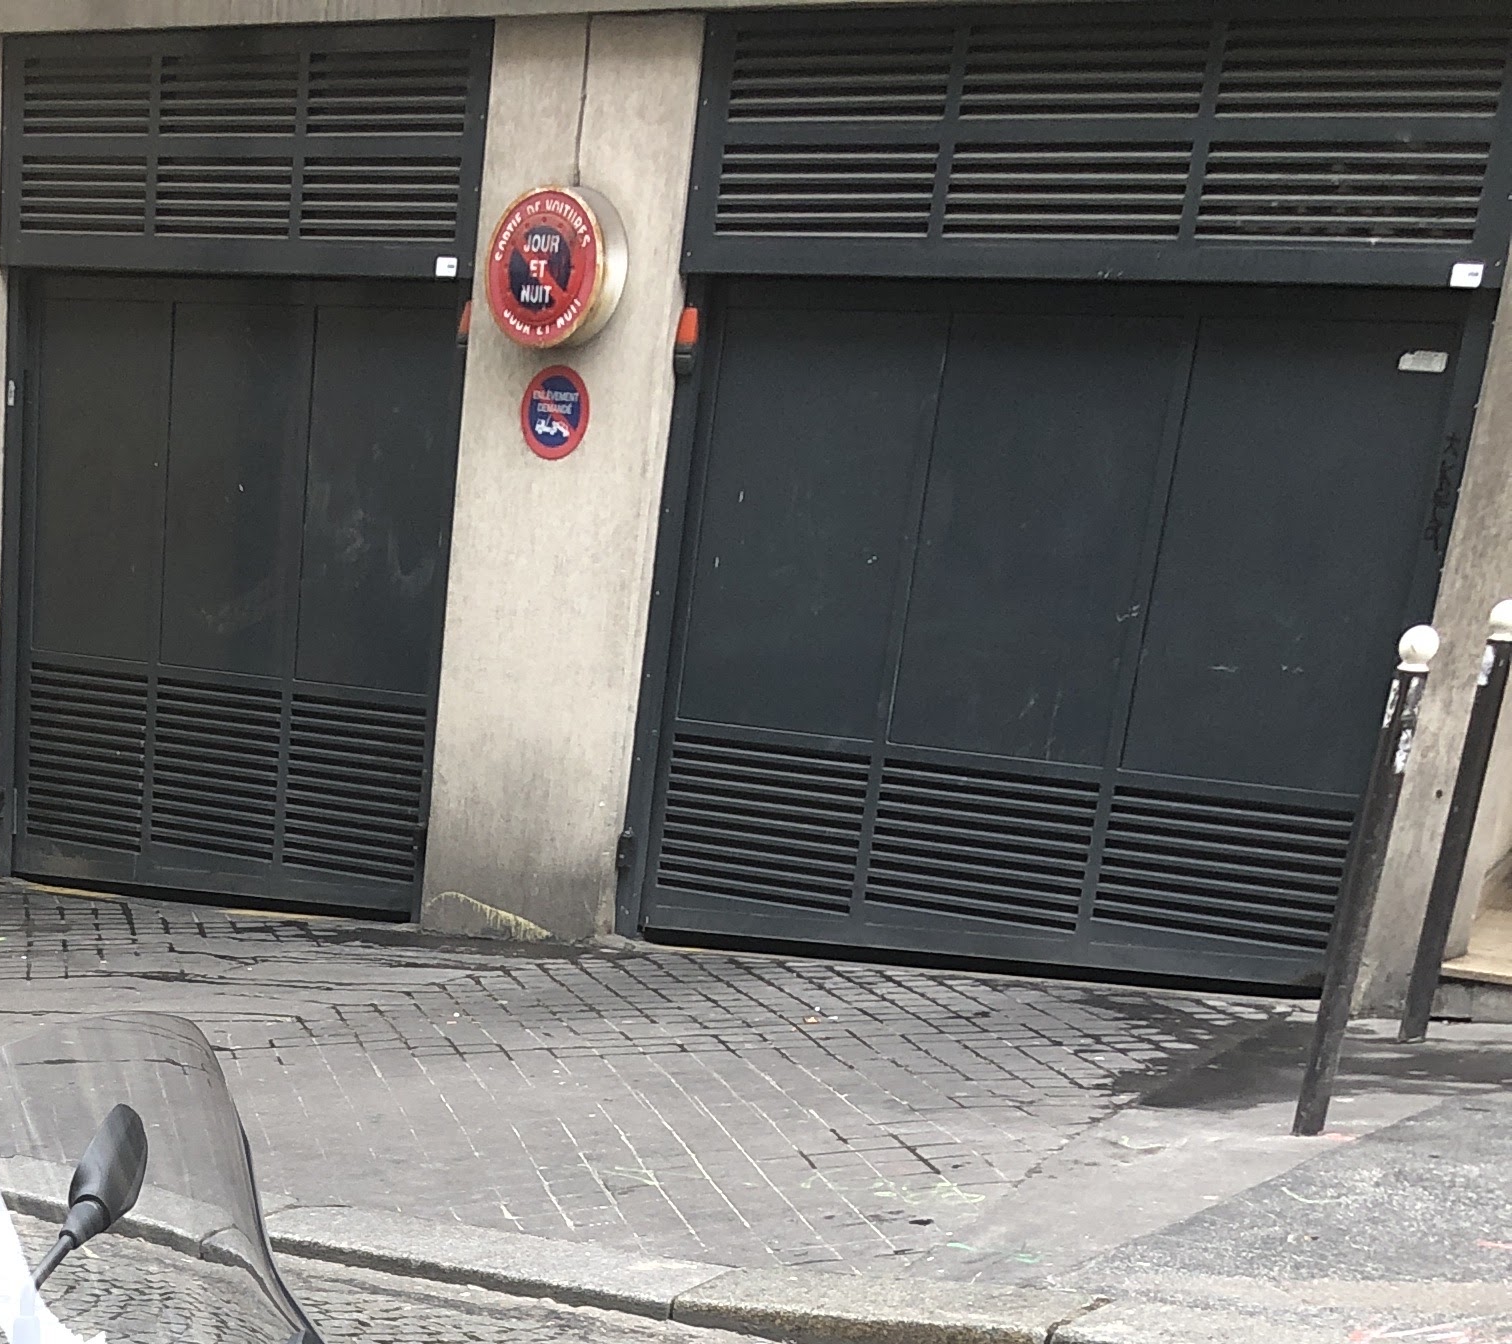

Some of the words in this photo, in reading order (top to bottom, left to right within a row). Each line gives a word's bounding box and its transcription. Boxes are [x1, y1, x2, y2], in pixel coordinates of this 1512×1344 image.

[523, 234, 560, 253] JOUR
[530, 259, 548, 278] ET
[520, 285, 552, 303] NUIT
